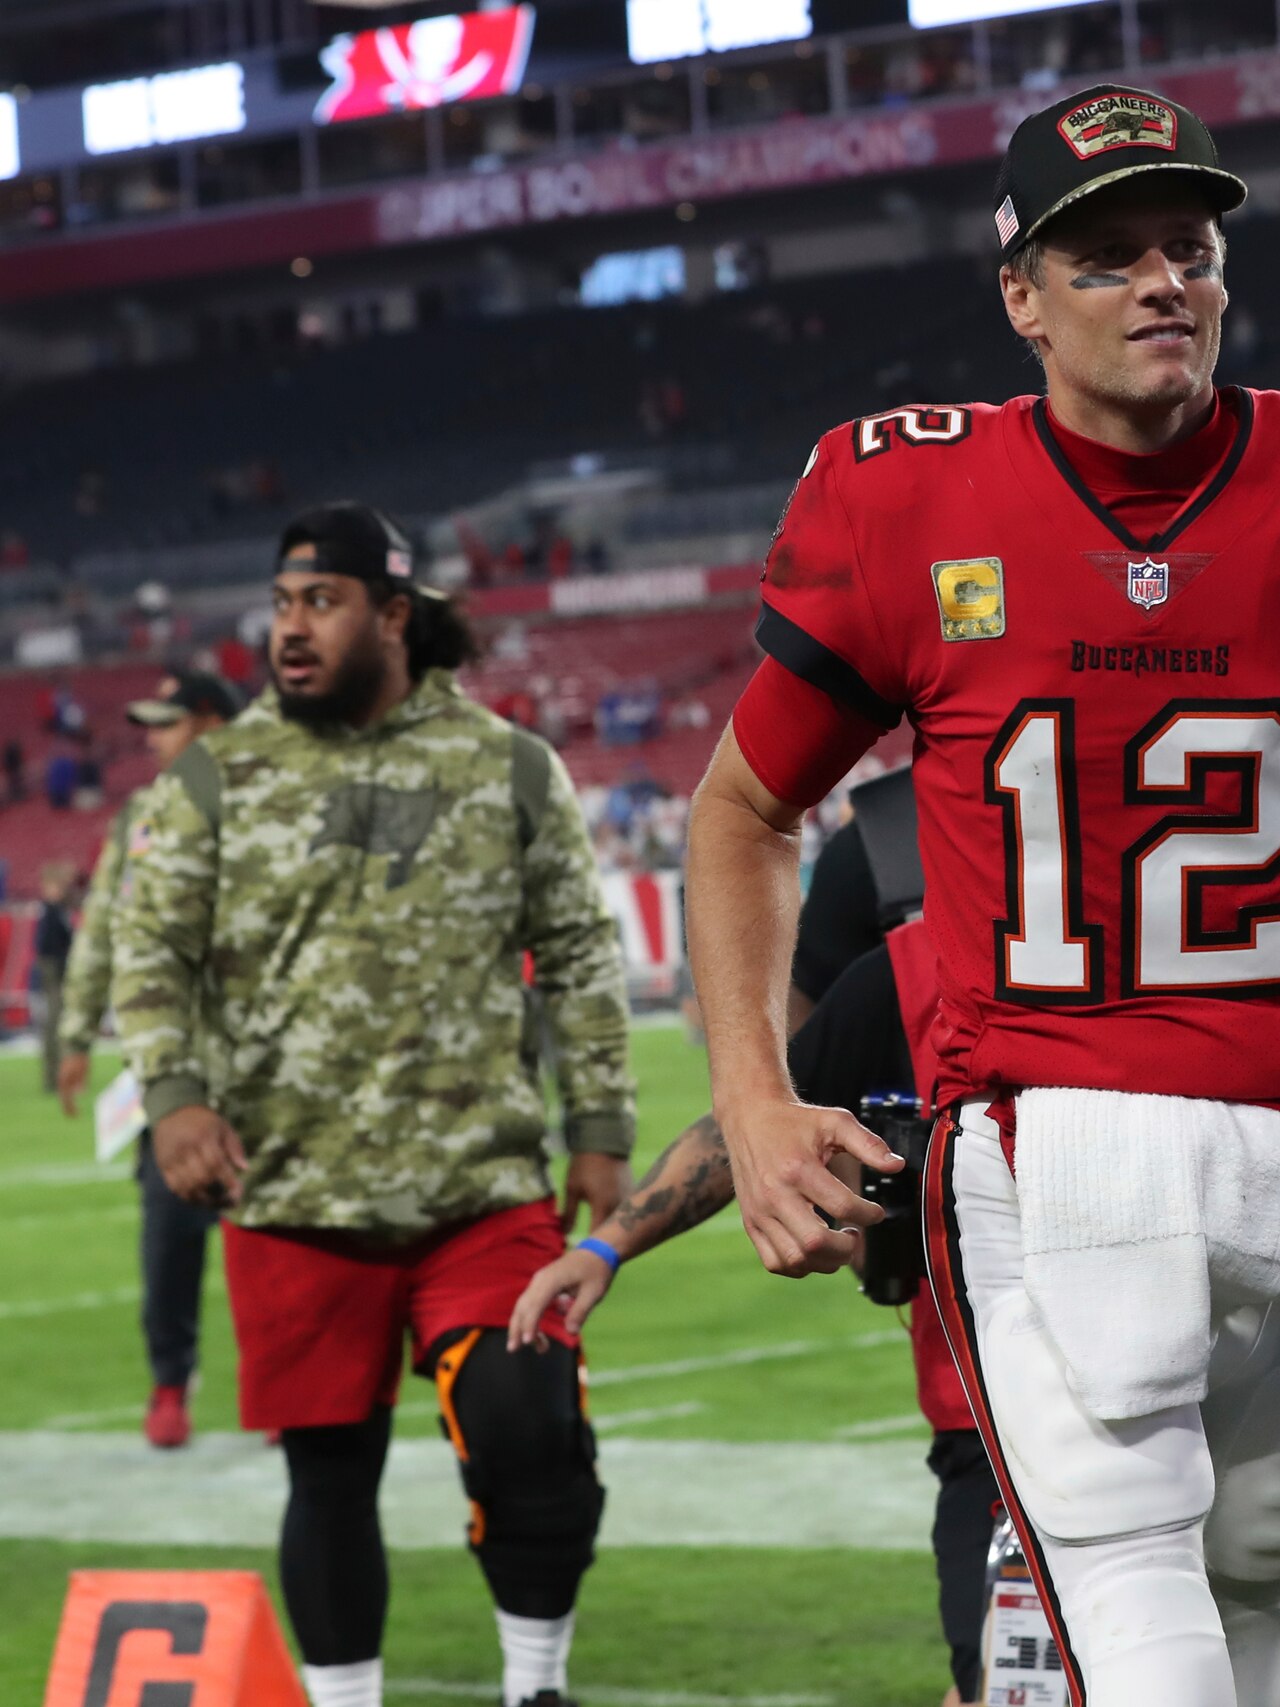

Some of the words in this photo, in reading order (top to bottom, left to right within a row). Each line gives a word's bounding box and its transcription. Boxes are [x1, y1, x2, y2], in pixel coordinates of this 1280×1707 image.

[1067, 98, 1166, 128] BUCCANEERS
[937, 564, 998, 620] C
[1134, 579, 1164, 598] NFL
[1071, 640, 1229, 677] BUCCANEERS
